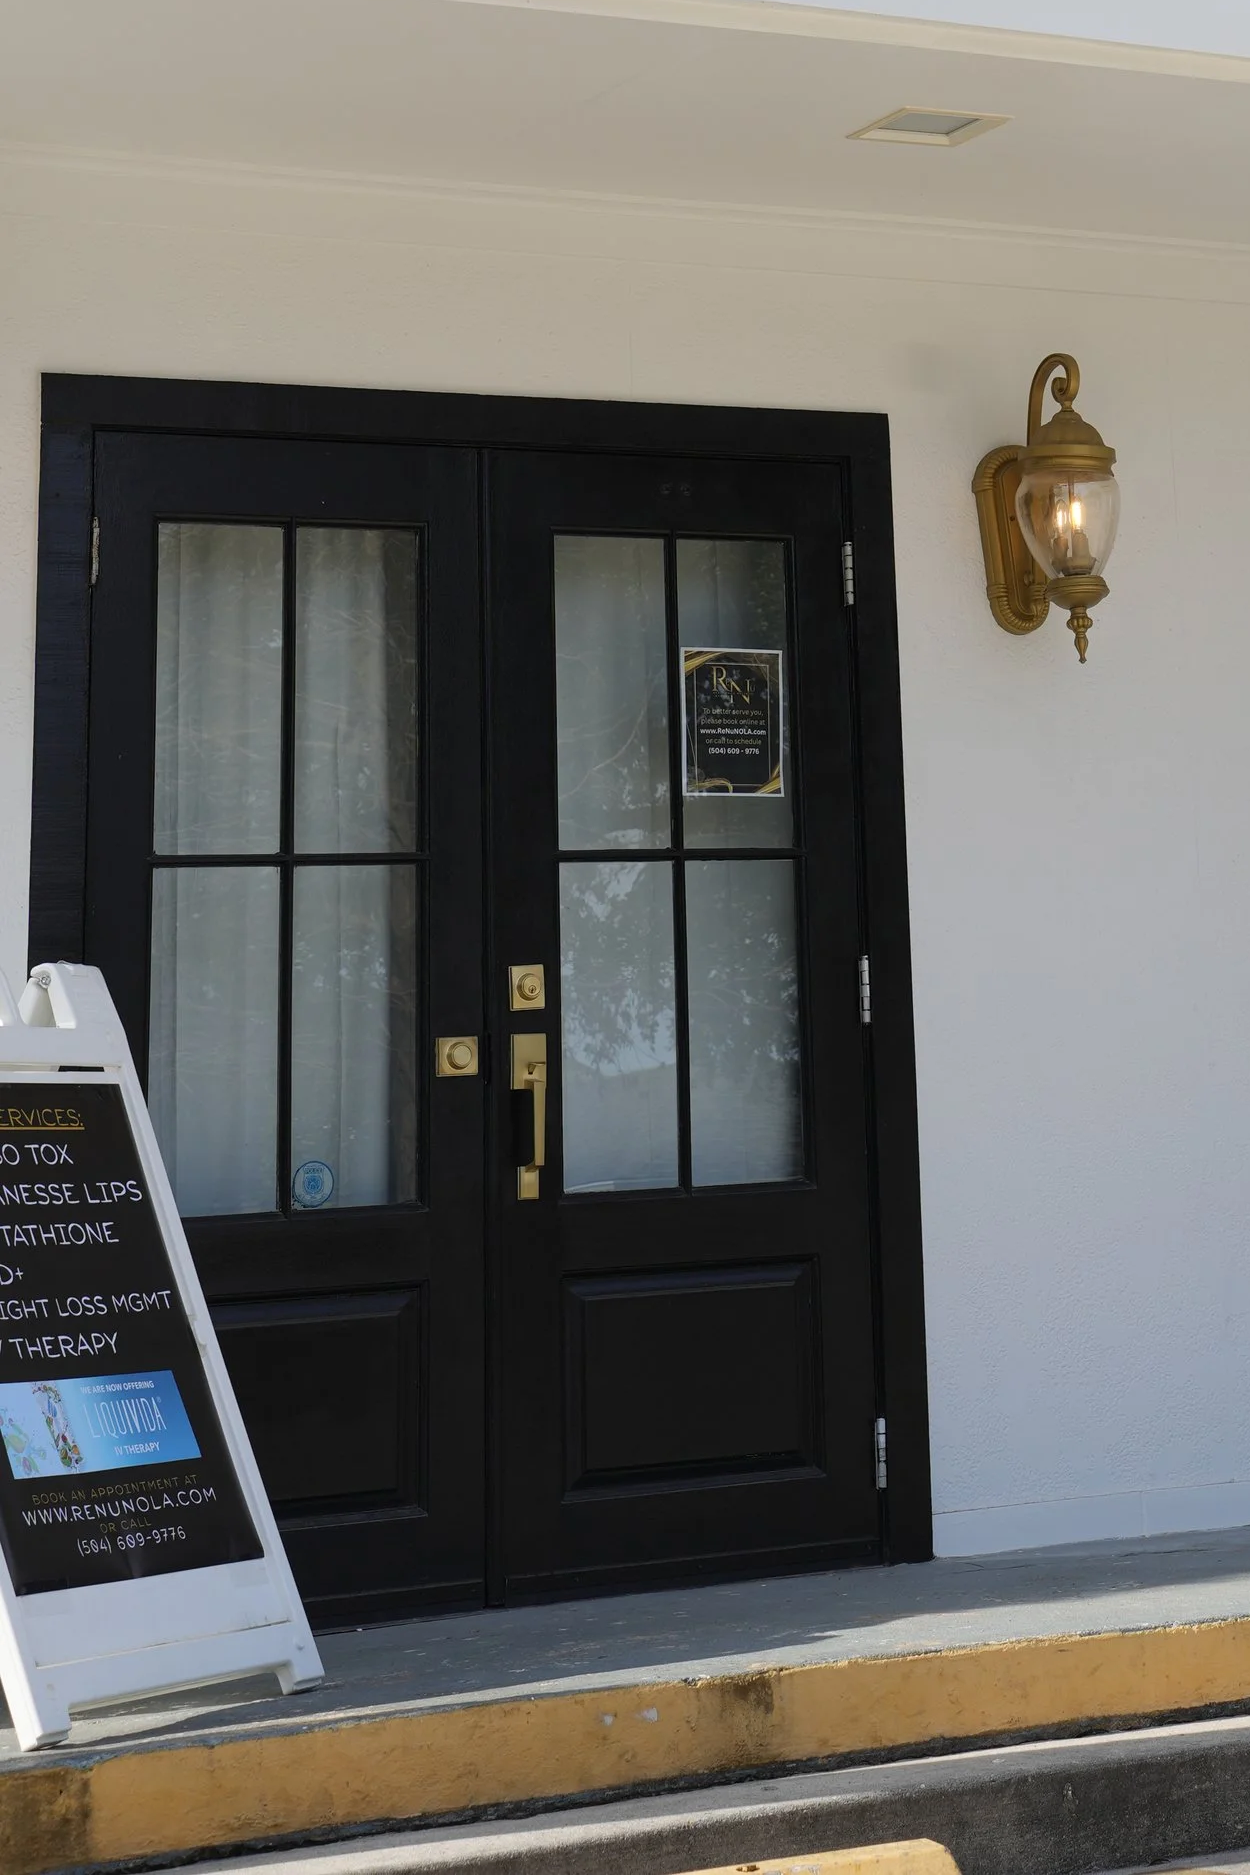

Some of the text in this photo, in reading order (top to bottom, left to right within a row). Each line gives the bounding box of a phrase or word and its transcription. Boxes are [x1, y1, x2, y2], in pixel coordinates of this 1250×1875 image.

[708, 747, 726, 755] (504)
[745, 747, 760, 755] 9776
[734, 737, 762, 745] schedule
[24, 1143, 74, 1166] TOX
[83, 1180, 143, 1204] LIPS
[55, 1296, 108, 1317] LOSS
[111, 1290, 171, 1314] MGMT
[8, 1331, 118, 1360] THERAPY
[92, 1385, 106, 1394] ARE
[106, 1382, 122, 1393] NOW
[122, 1380, 155, 1392] OFFERING
[114, 1441, 161, 1457] IV THERAPY
[31, 1474, 198, 1506] BOOK AN APPOINTMENT AT
[21, 1486, 217, 1527] WWW.RENUNOLA.COM
[100, 1517, 152, 1534] OR CALL
[76, 1525, 187, 1558] (504) 609-9776
